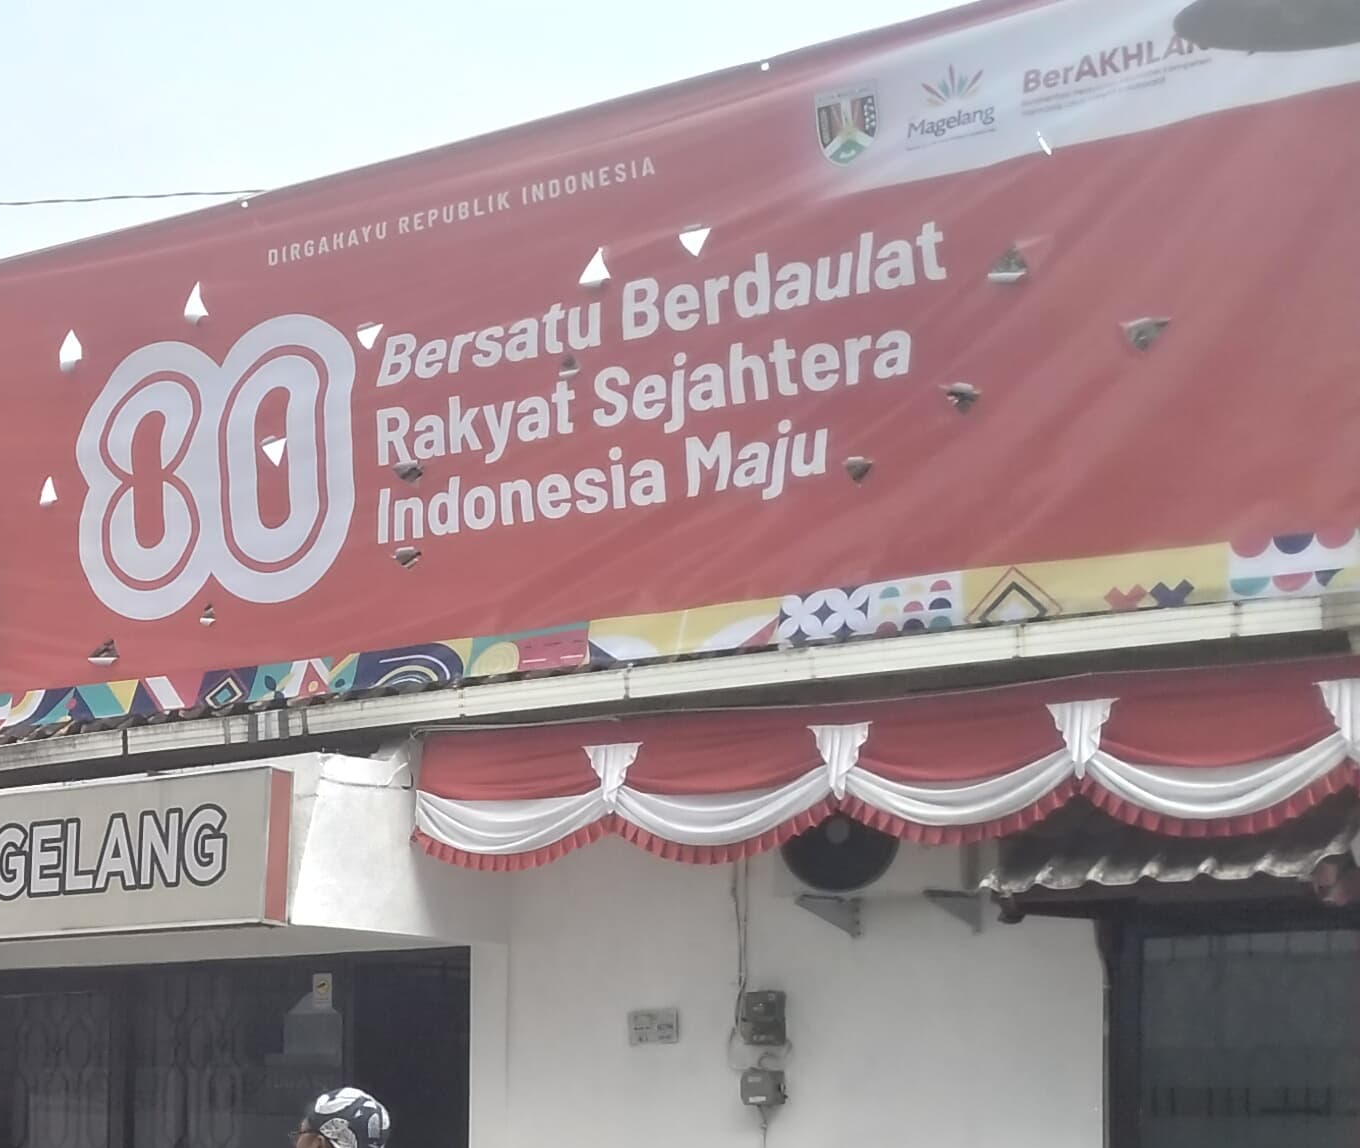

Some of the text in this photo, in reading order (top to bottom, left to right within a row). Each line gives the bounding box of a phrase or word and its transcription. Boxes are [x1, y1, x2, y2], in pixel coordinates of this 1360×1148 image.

[907, 106, 995, 138] Magelang
[1023, 34, 1208, 93] BerAKHLA
[267, 156, 657, 266] DIRGAHAYU REPUBLIK INDONESIA
[376, 221, 947, 387] Bersatu Berdaulat
[376, 328, 912, 467] Rakyat Sejahtera
[75, 313, 356, 620] 80
[377, 419, 828, 545] Indonesia Maju
